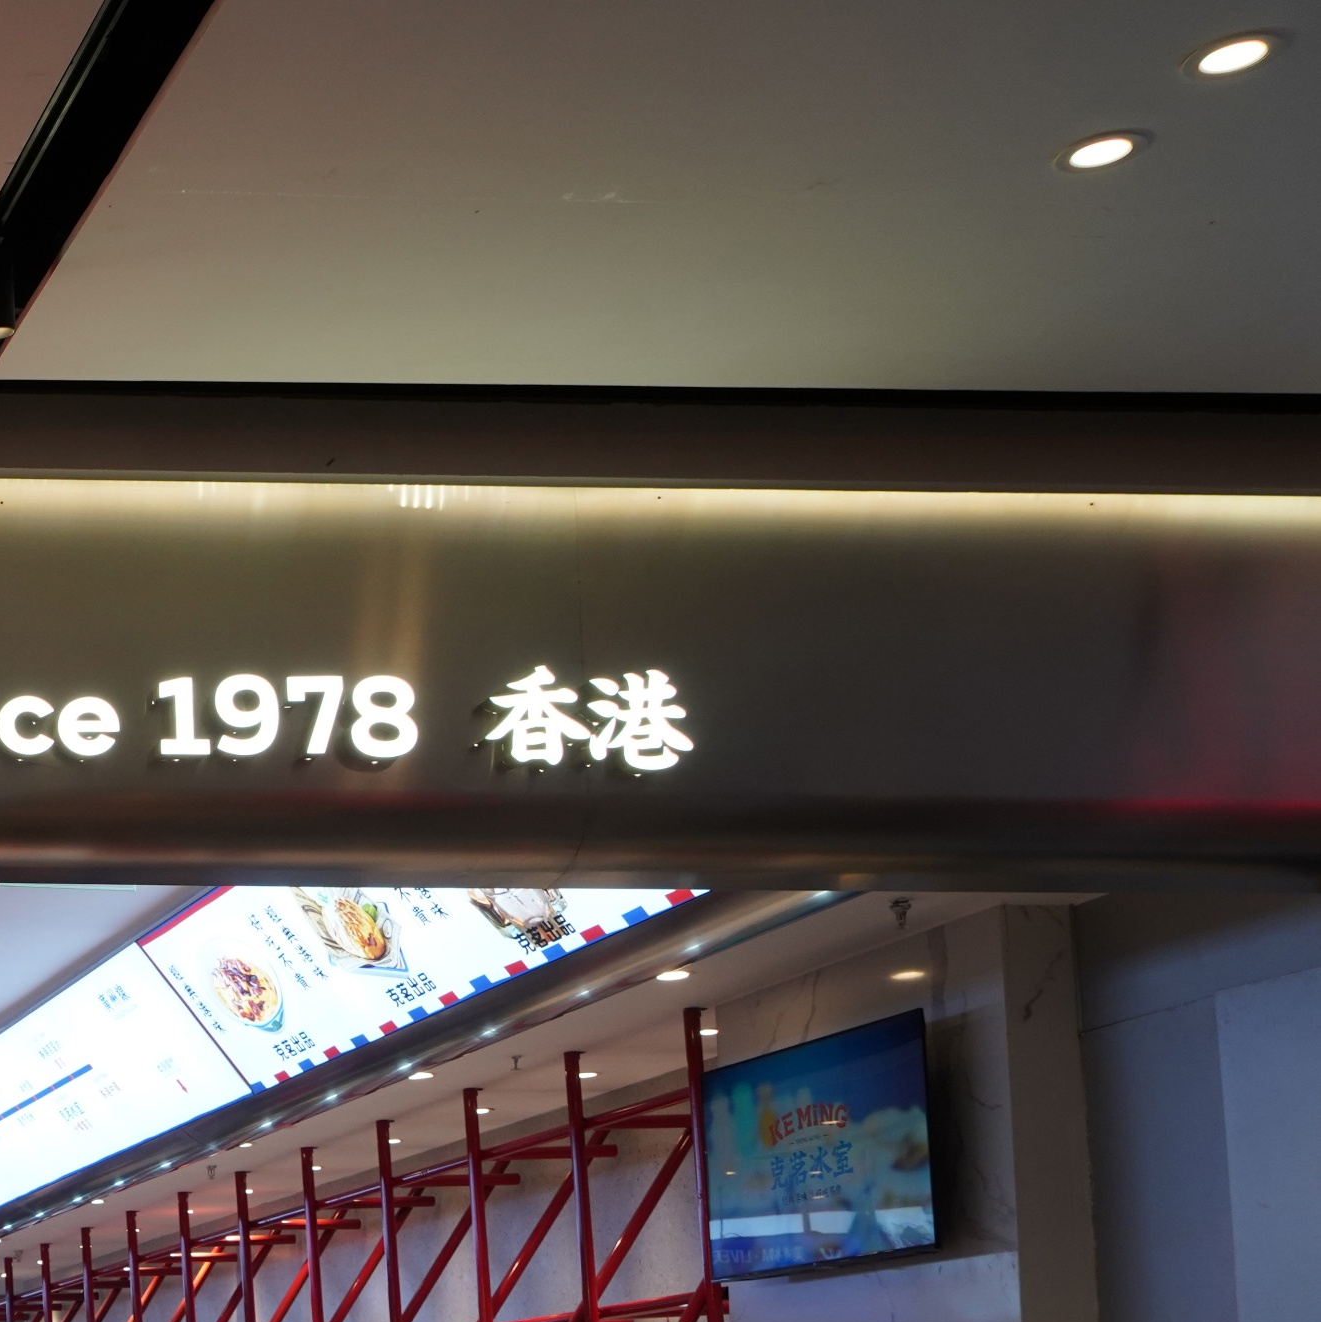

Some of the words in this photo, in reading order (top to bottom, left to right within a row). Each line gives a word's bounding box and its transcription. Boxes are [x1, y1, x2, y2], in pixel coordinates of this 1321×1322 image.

[158, 674, 419, 758] 1978
[487, 665, 694, 772] 香港
[517, 913, 577, 956] 克茗出品
[384, 970, 439, 1009] 克茗出品
[272, 1030, 316, 1063] 克茗出品
[770, 1140, 854, 1191] 克茗冰室
